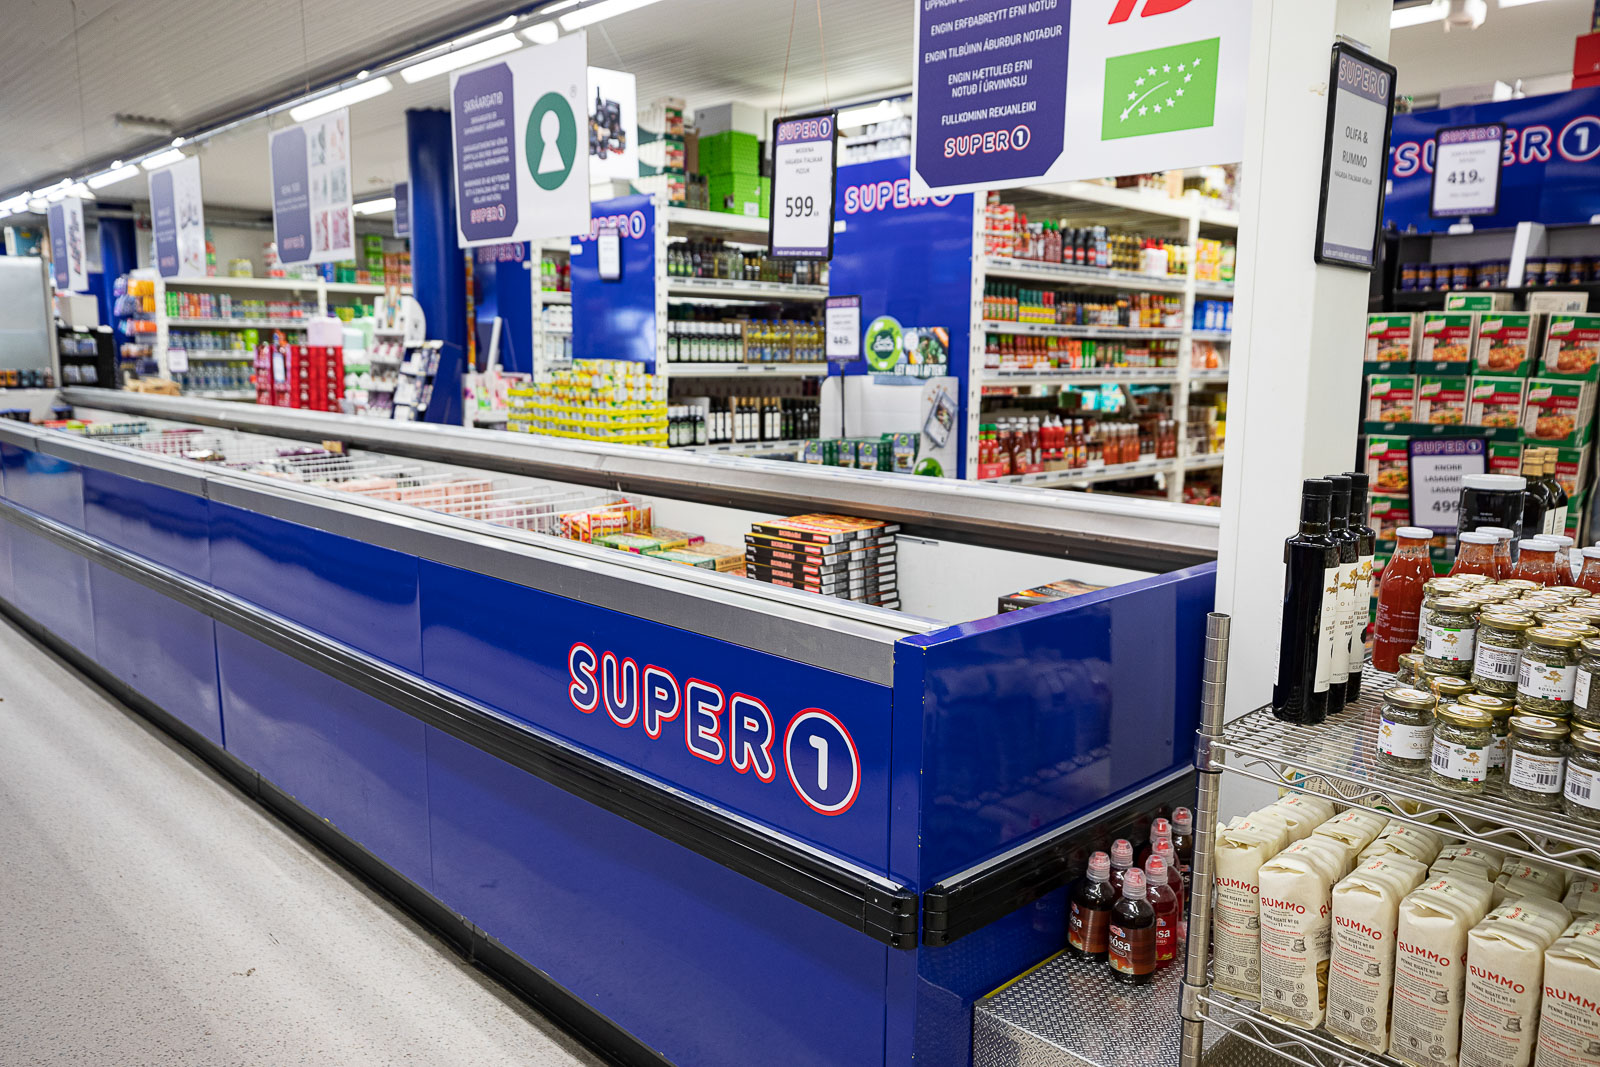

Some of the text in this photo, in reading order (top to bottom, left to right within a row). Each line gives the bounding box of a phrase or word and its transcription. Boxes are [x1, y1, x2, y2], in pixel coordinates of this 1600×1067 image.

[931, 0, 1058, 36] ENGIN ERFÐABREYTT EFNI NOTUÐ
[925, 25, 1063, 64] ENGIN TILBÚINN ÁBURÐUR NOTAÐUR
[948, 59, 1033, 85] ENGIN HÆTTULEG EFNI
[1339, 58, 1377, 94] SUPER
[951, 74, 1028, 98] NOTUÐ Í ÚRVINNSLU
[941, 100, 1037, 126] FULLKOMINN REKJANLEIKI
[779, 121, 818, 141] SUPER
[944, 129, 1010, 158] SUPER
[1345, 126, 1369, 144] OLIFA &
[1441, 127, 1486, 144] SUPER
[1342, 150, 1368, 168] RUMMO
[1393, 125, 1553, 177] SUER
[1447, 169, 1478, 184] 419
[785, 196, 814, 218] 599
[844, 178, 928, 214] SUPE
[1413, 440, 1465, 454] SUPER
[568, 642, 776, 783] SUPER
[1216, 877, 1259, 895] RUMMO
[1261, 897, 1305, 914] RUMMO
[1335, 916, 1382, 940] RUMMO
[1399, 941, 1450, 967] RUMMO
[1470, 965, 1525, 994] RUMMO
